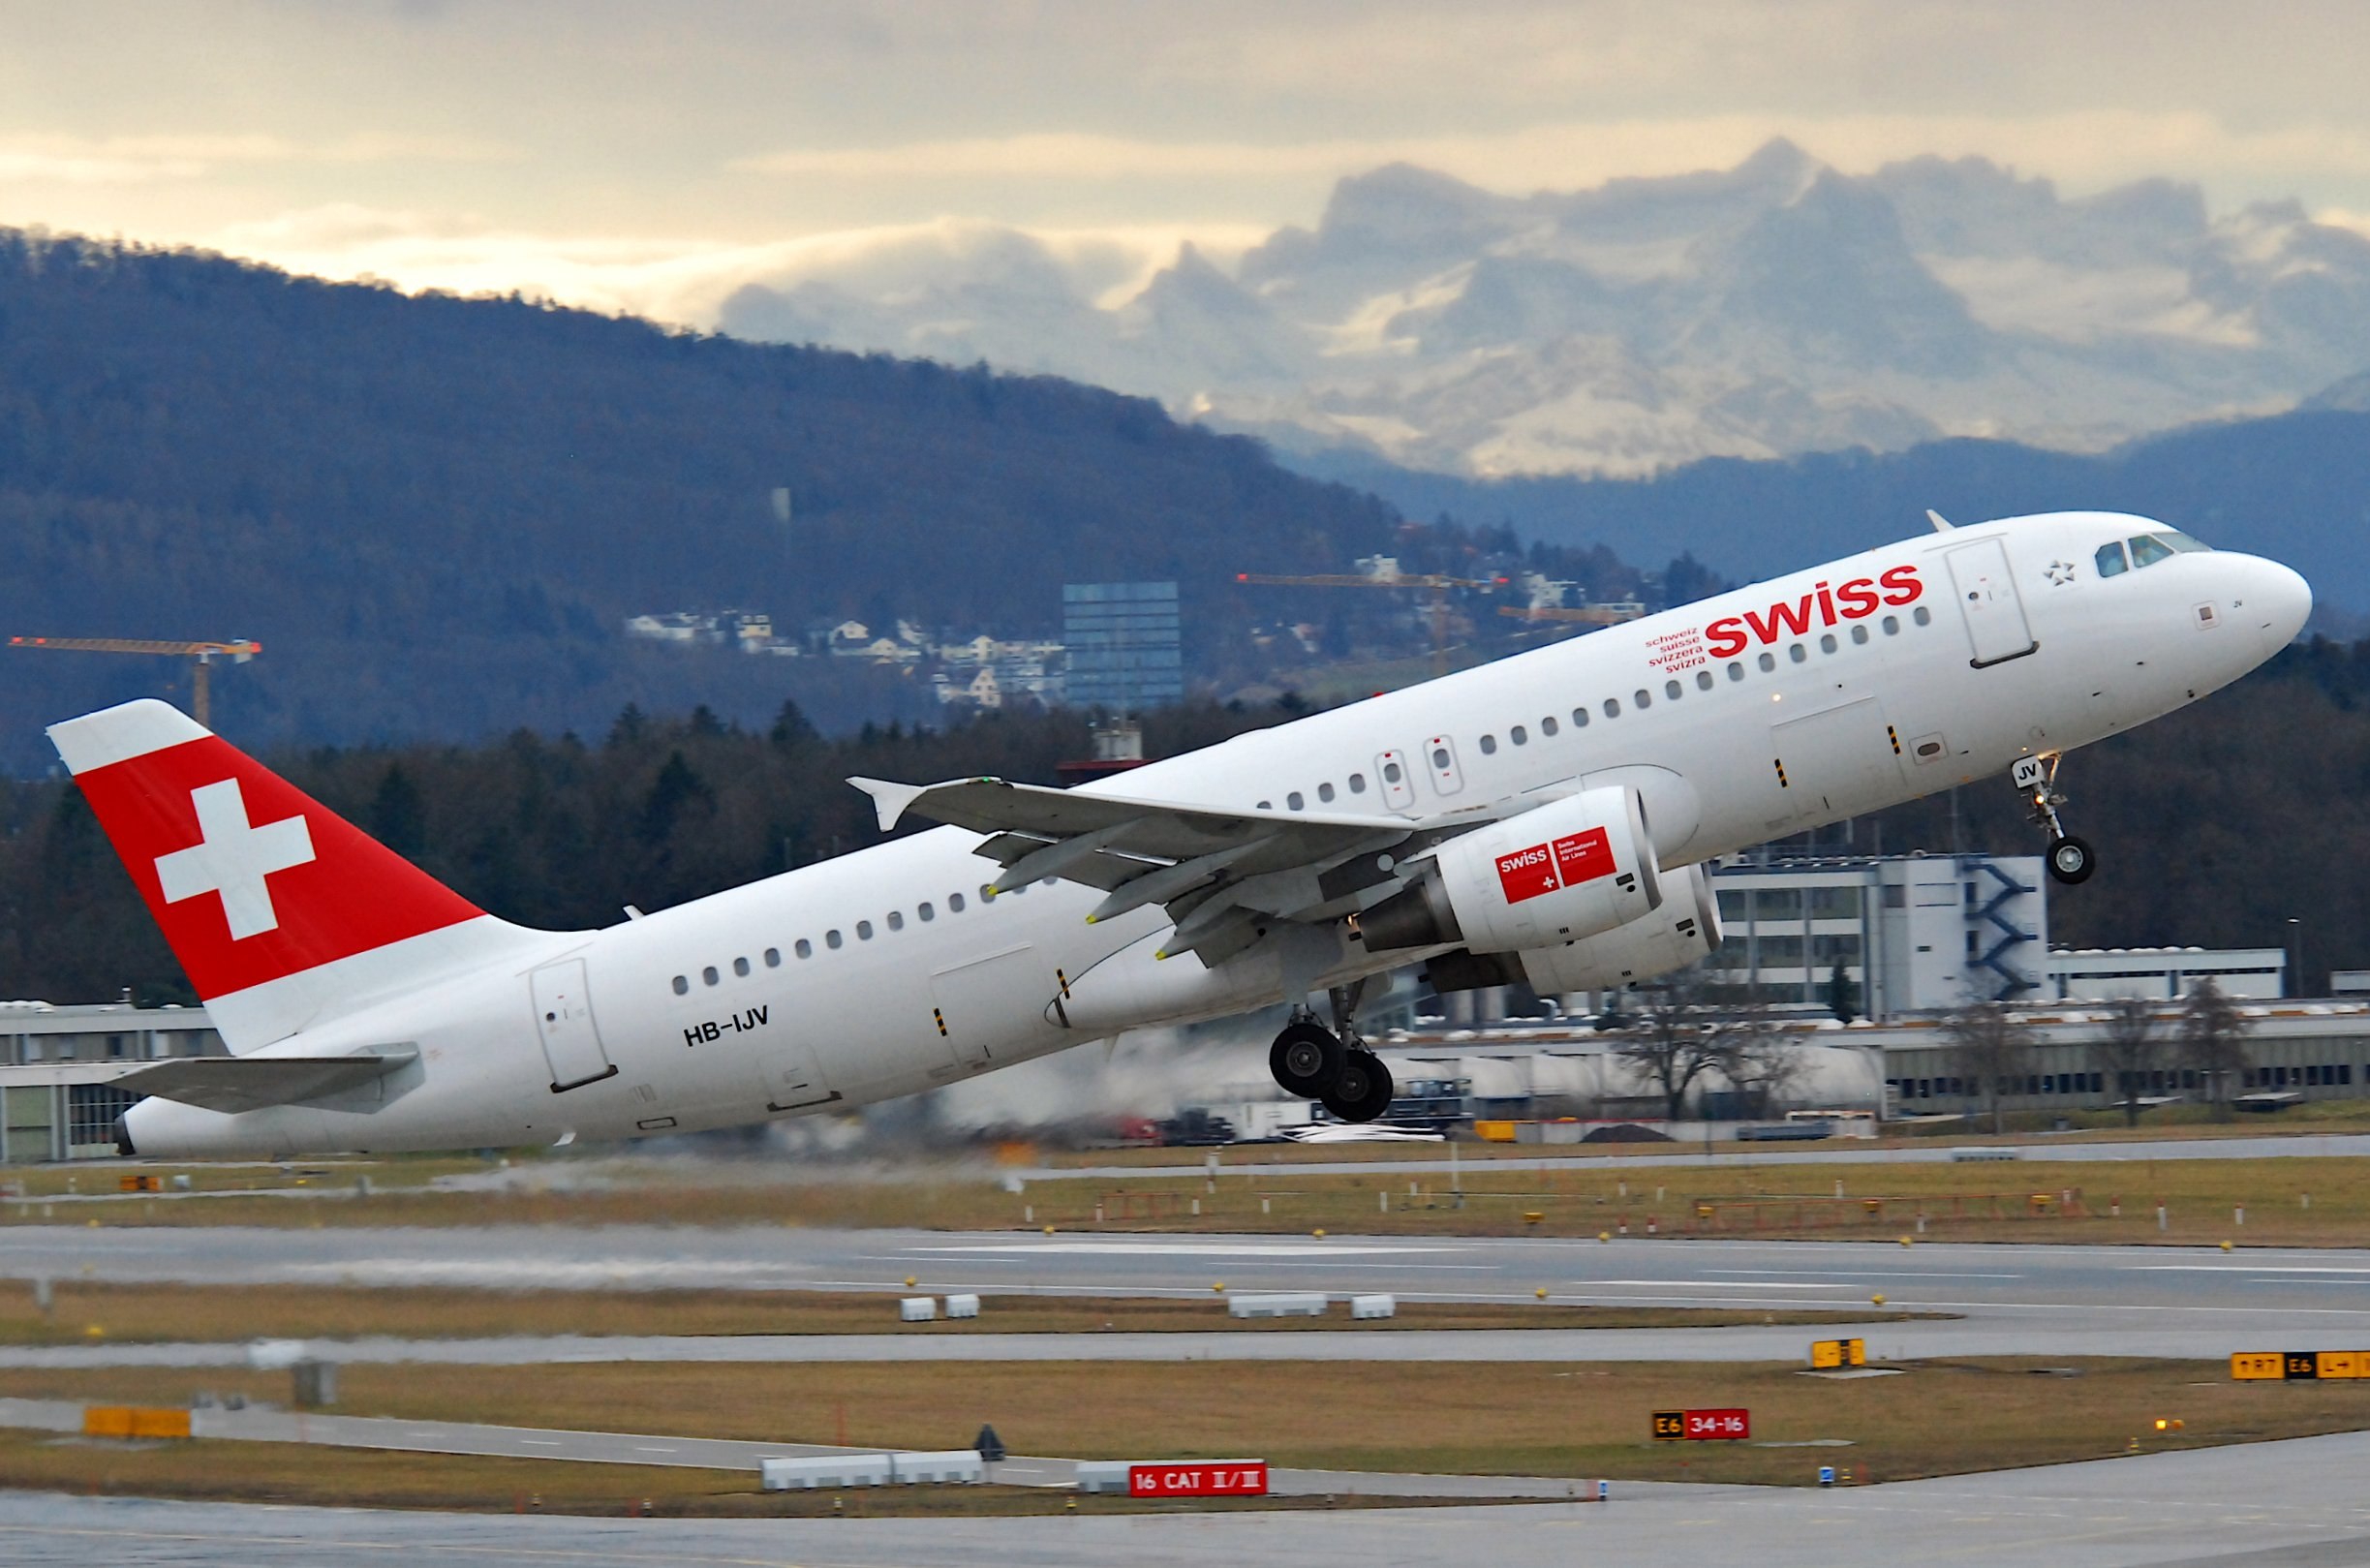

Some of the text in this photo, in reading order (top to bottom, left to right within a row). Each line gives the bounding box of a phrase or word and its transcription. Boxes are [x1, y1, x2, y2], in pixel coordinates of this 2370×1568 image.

[1706, 566, 1923, 658] swiss
[1646, 628, 1698, 647] schweiz
[1660, 636, 1700, 653] suisse
[1648, 646, 1704, 667] svizzera
[1666, 657, 1706, 673] svizra
[2018, 763, 2036, 780] JV
[1500, 849, 1548, 873] swiss
[684, 1004, 767, 1047] HB-IJV
[2288, 1358, 2313, 1372] E6
[1656, 1417, 1744, 1433] E6 34-16
[1135, 1473, 1157, 1490] 16
[1164, 1472, 1202, 1489] CAT
